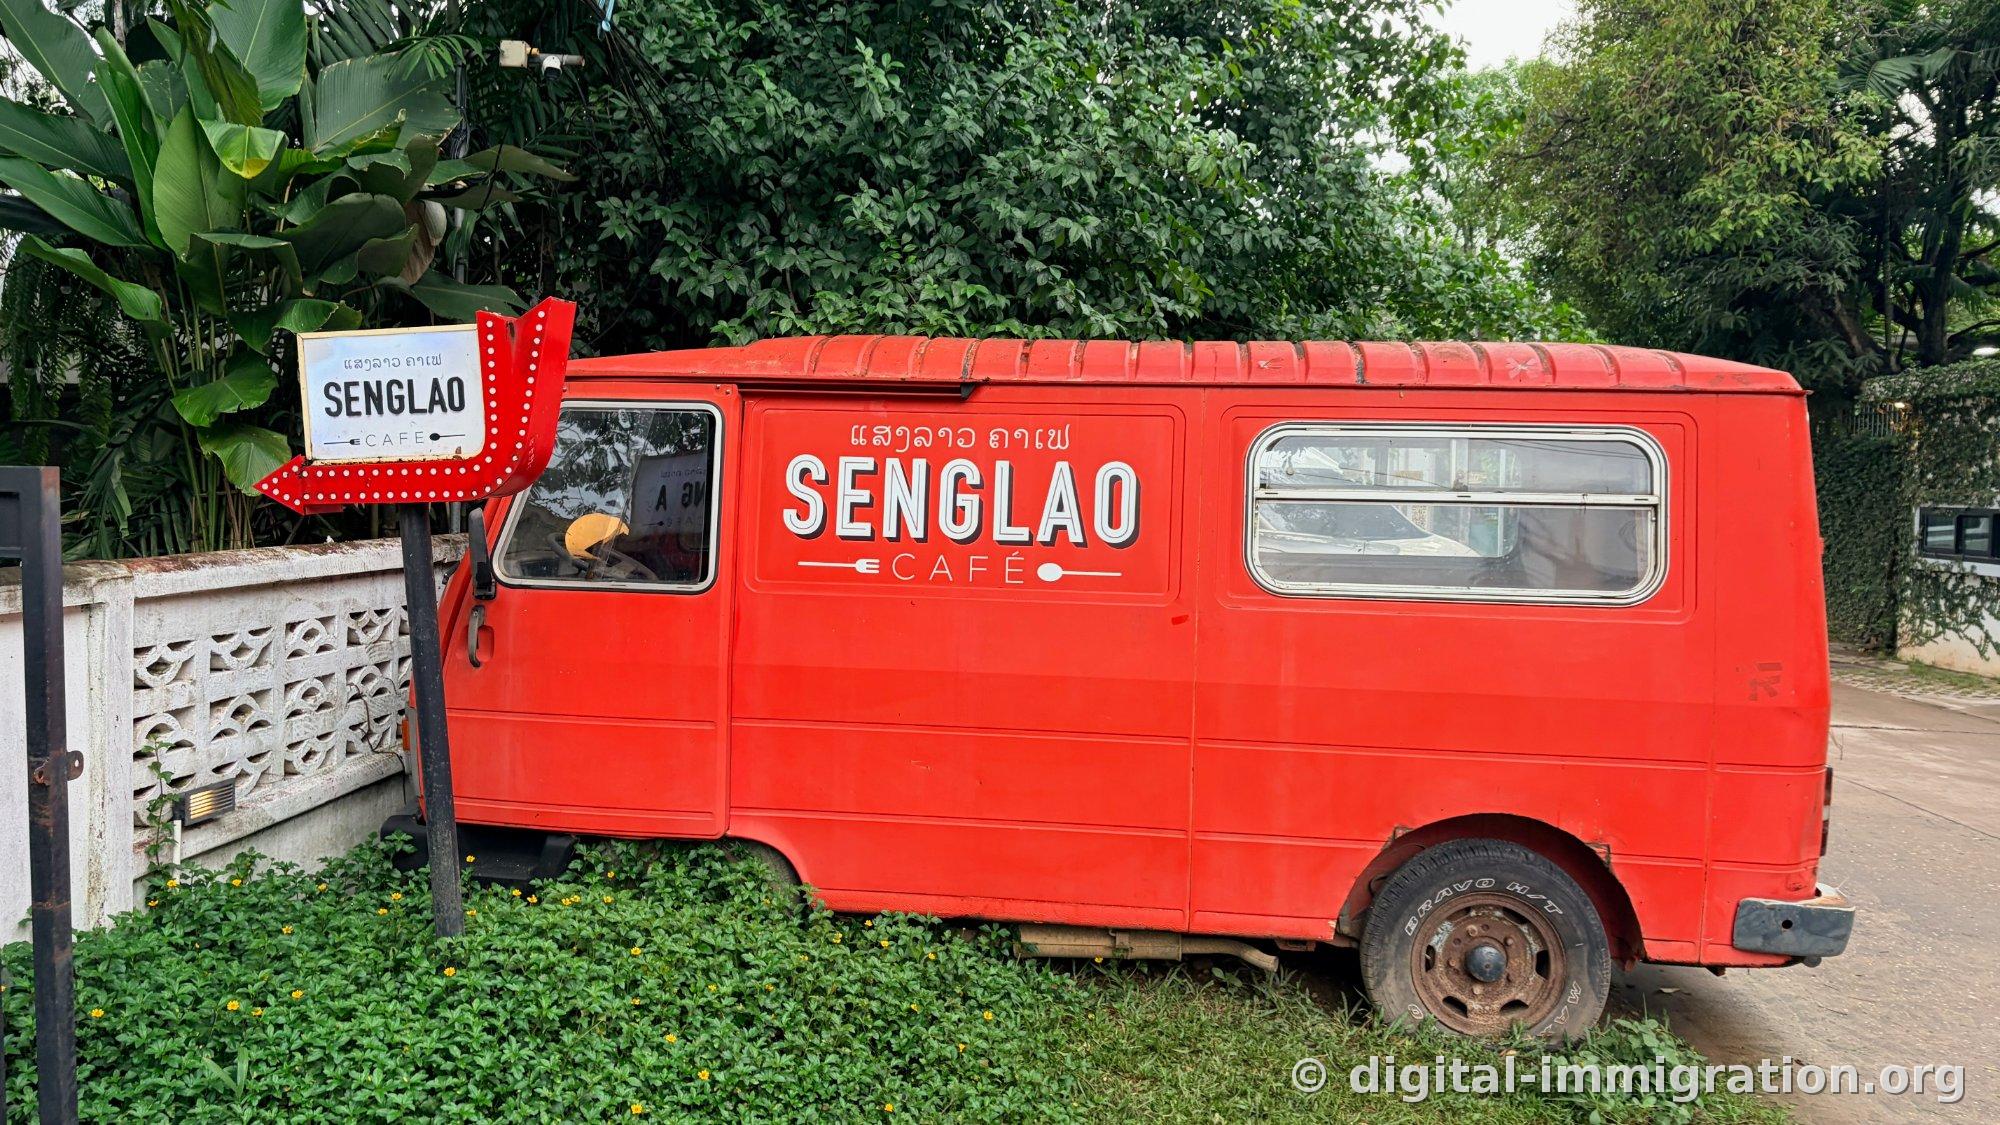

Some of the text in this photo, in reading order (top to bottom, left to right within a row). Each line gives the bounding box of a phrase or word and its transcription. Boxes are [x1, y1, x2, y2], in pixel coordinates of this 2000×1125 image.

[344, 353, 442, 371] ແສງລາວ ຄາເຟ
[323, 376, 466, 418] SENGLAO
[850, 423, 1071, 453] ແສງລາວ ຄາເຟ
[782, 453, 1142, 550] SENGLAO
[891, 550, 1026, 584] CAFÉ
[1404, 878, 1564, 937] BRAVO H/T
